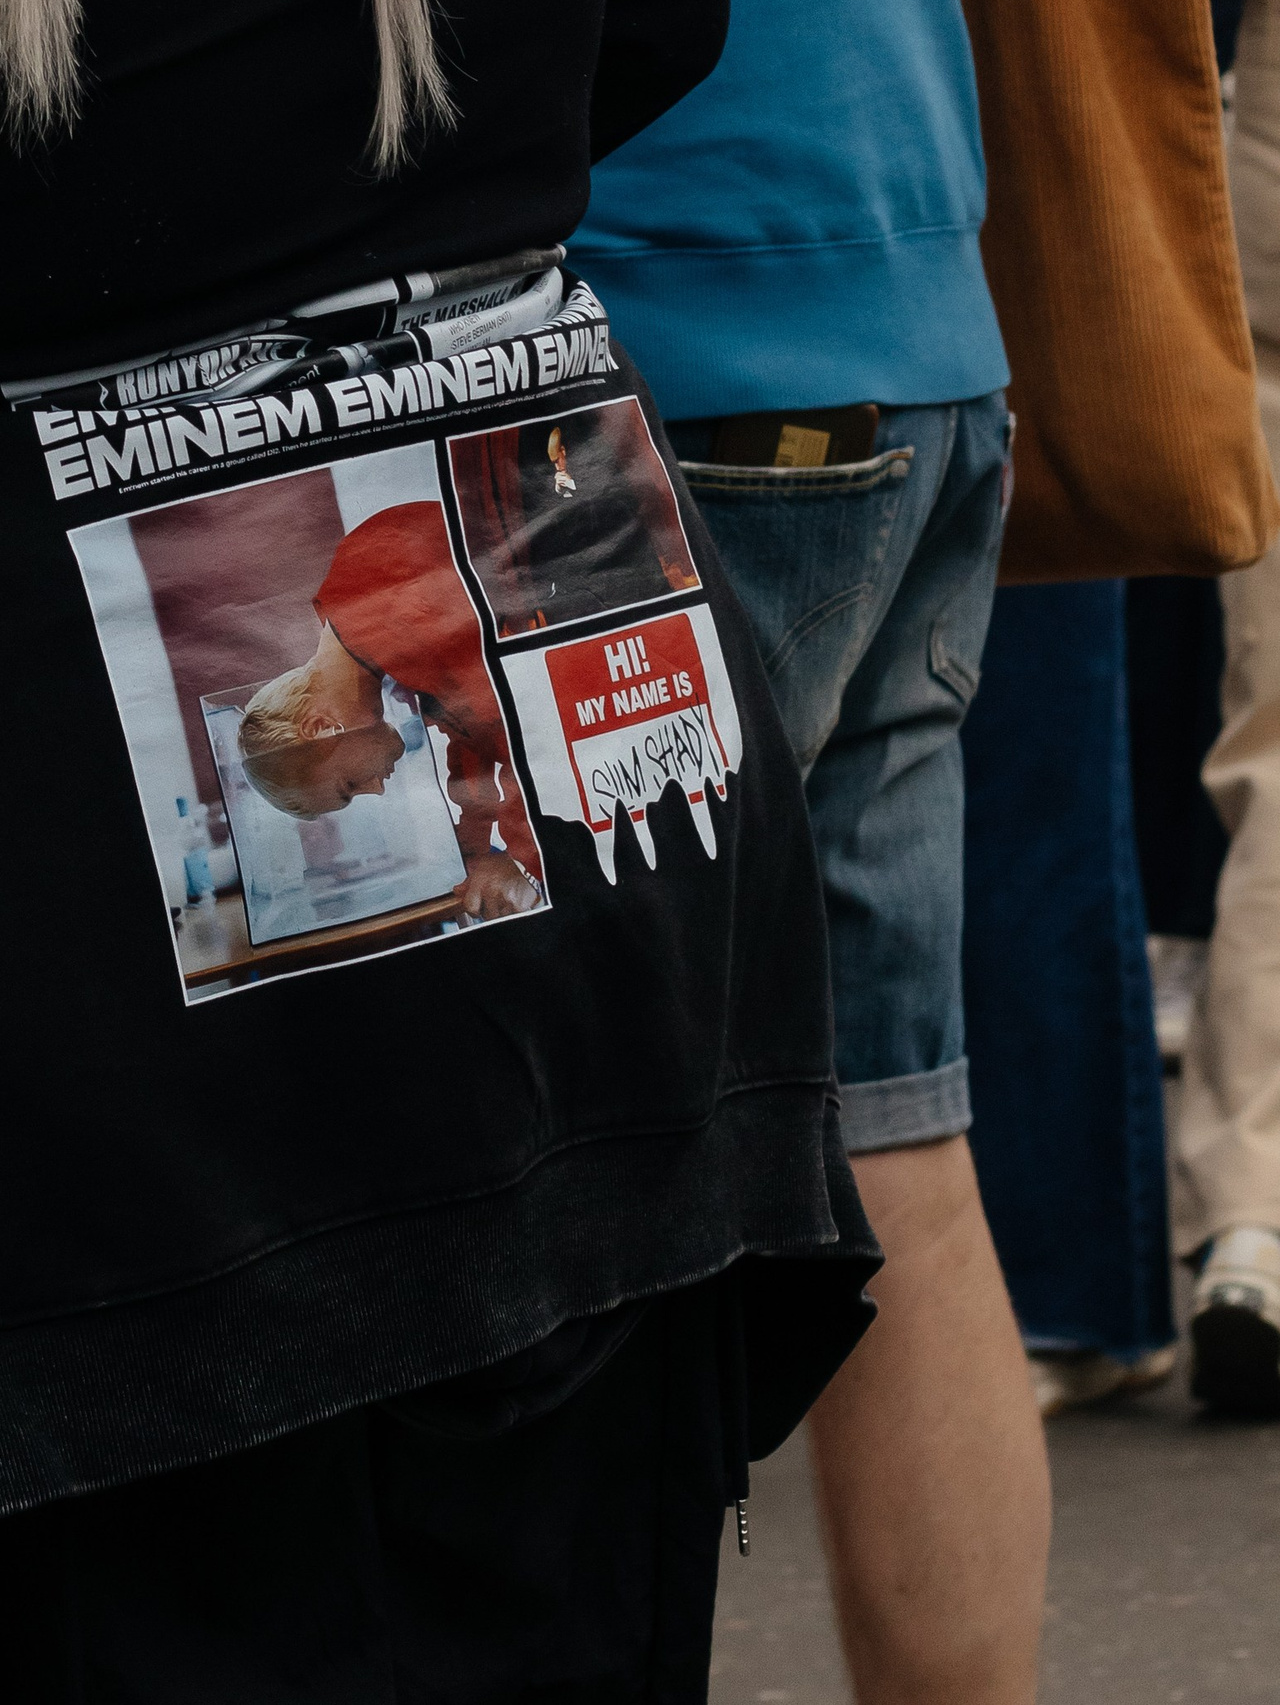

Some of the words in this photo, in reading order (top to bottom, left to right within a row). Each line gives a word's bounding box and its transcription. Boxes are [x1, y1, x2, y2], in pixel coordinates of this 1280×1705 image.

[401, 311, 432, 330] THE
[435, 286, 509, 323] MARSHALL
[44, 389, 322, 500] EMINEM
[324, 341, 530, 428] EMINEM
[119, 481, 149, 494] Eminem
[150, 473, 175, 486] started
[188, 465, 210, 475] career
[225, 458, 245, 468] group
[247, 451, 266, 462] called
[603, 635, 651, 683] HI!
[575, 695, 606, 727] MY
[612, 677, 671, 717] NAME
[672, 670, 693, 698] IS
[644, 692, 720, 790] SHADY
